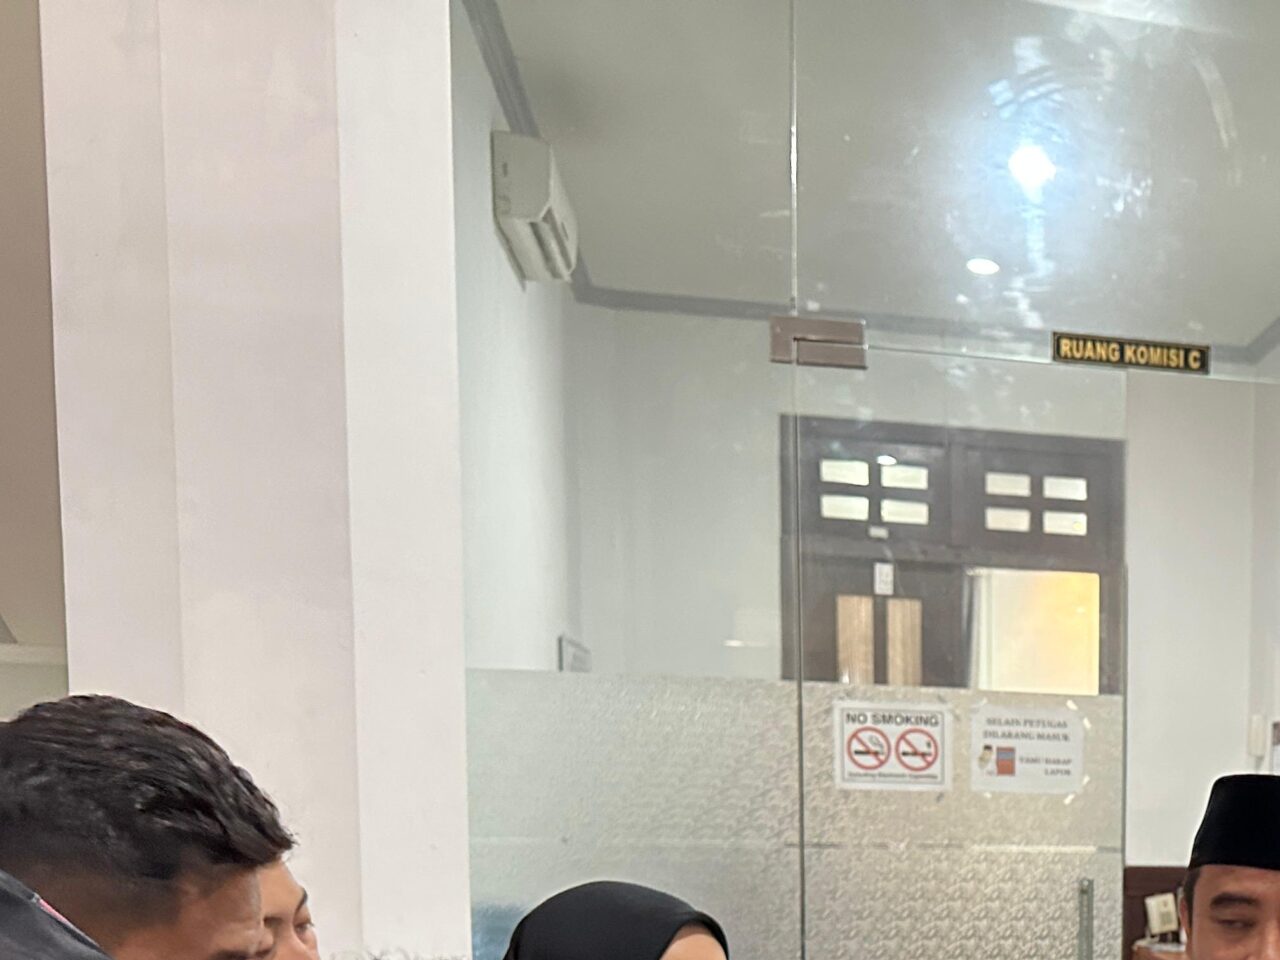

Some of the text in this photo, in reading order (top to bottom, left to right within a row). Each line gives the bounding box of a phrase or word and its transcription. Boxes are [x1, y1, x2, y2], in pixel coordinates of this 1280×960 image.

[1060, 338, 1200, 369] RUANG KOMISI C
[846, 713, 939, 726] NO SMOKING
